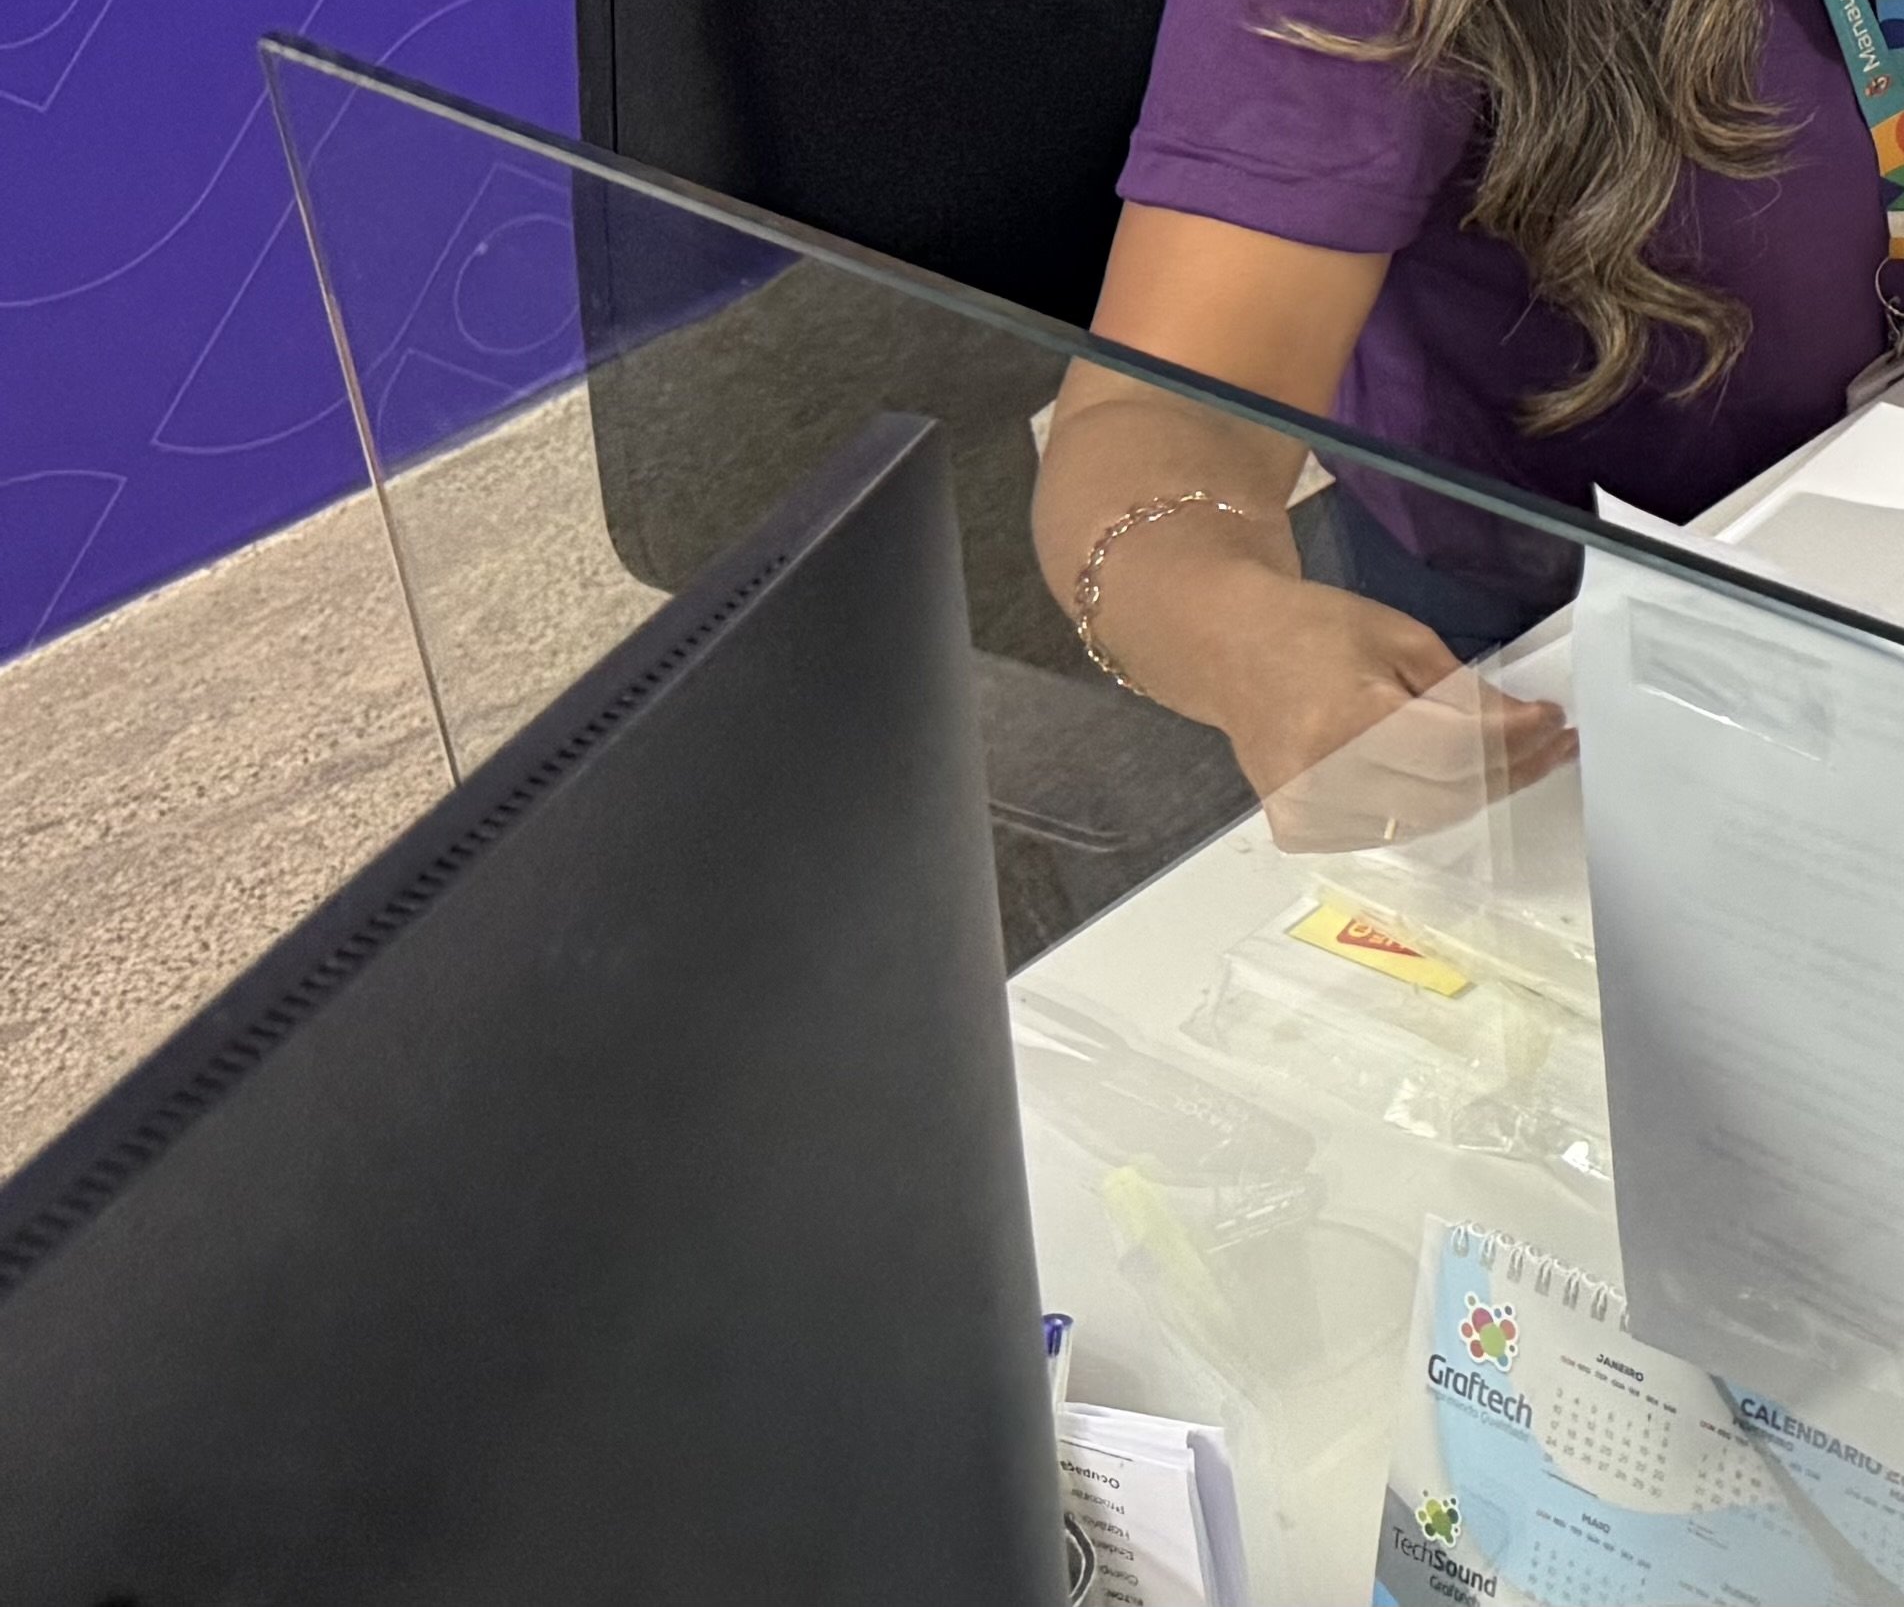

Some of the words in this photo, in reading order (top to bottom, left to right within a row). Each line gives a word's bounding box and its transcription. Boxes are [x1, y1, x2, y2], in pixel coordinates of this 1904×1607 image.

[1427, 1353, 1533, 1429] Graftech
[1596, 1353, 1645, 1382] JANEIRO
[1739, 1397, 1883, 1475] CALENDARIO
[1392, 1526, 1498, 1598] TechSound
